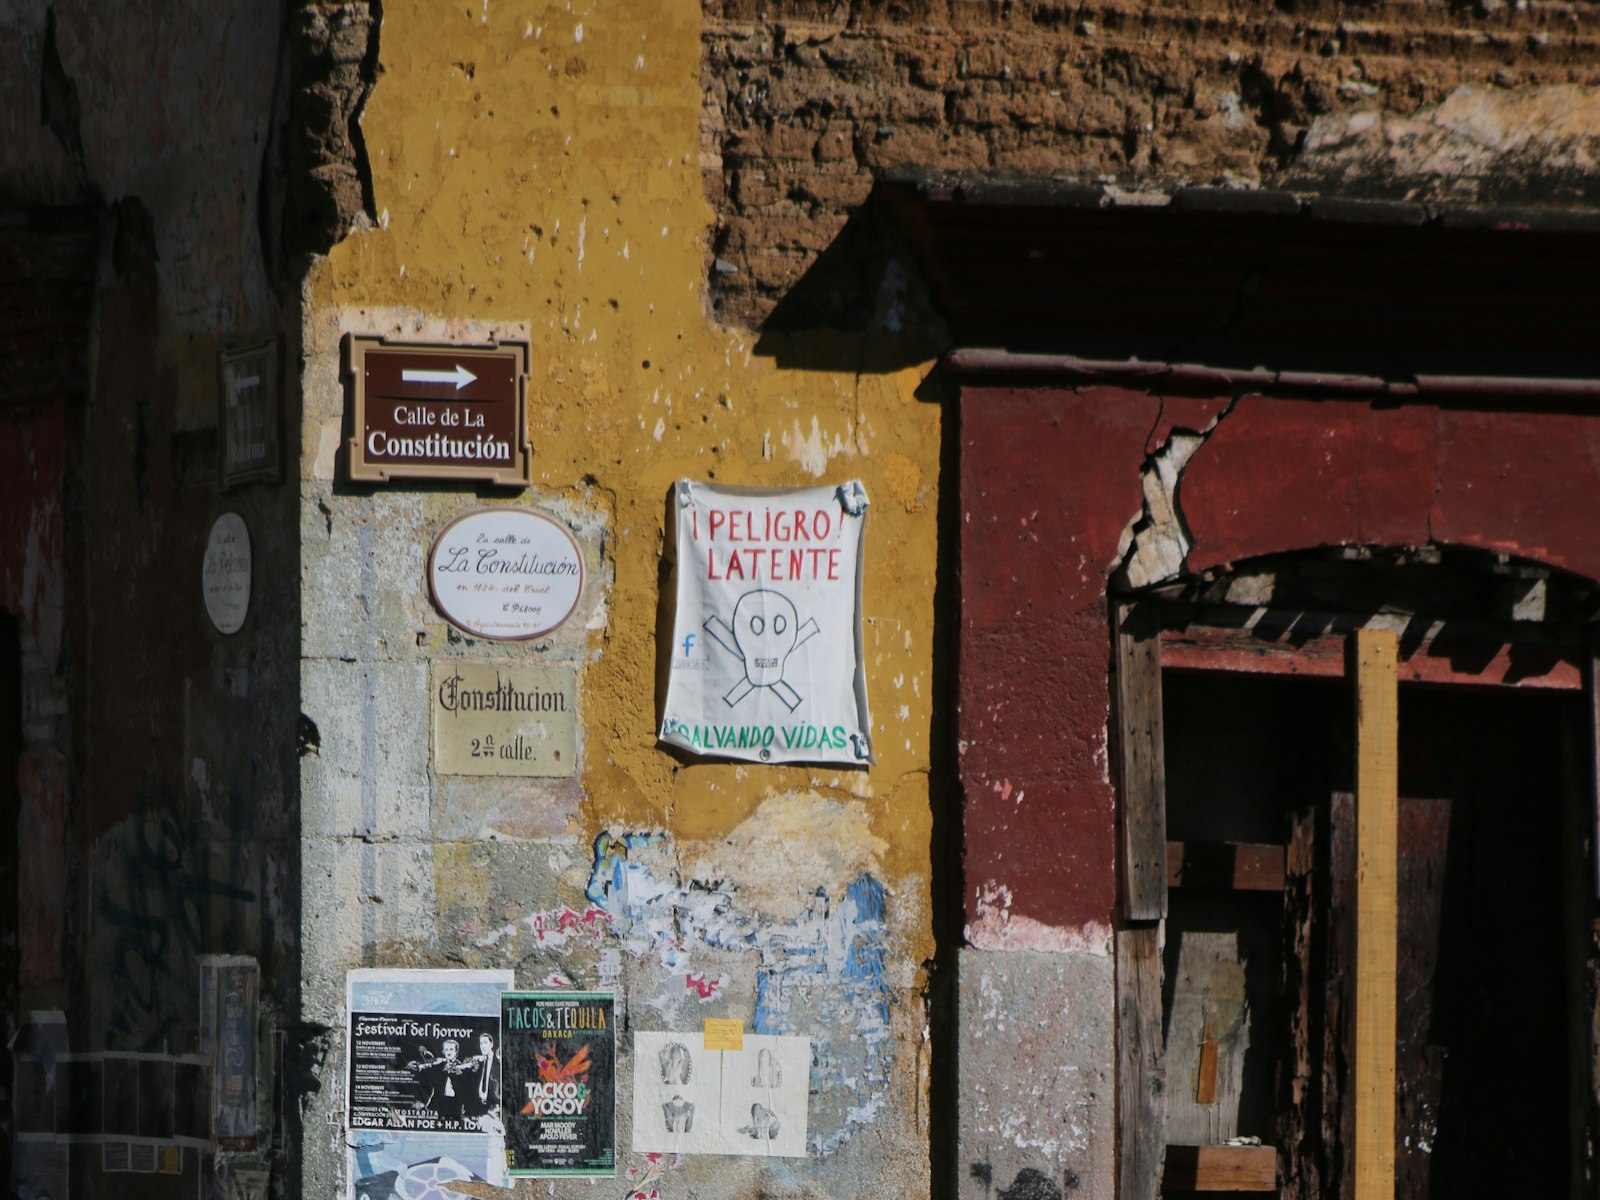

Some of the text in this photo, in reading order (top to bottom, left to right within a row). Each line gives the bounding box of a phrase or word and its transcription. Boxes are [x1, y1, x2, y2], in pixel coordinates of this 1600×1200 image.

[394, 406, 485, 427] Calle de La
[368, 431, 510, 460] Constitución
[492, 534, 516, 544] calle
[520, 536, 532, 544] de
[438, 547, 580, 576] La Constitución
[708, 548, 842, 580] LATENTE
[678, 720, 848, 750] SALVANDO VIDAS
[356, 1022, 474, 1040] Festival del horror
[542, 1030, 572, 1038] OAXACA
[530, 1098, 586, 1115] YOSOY
[352, 1118, 384, 1127] EDGAR
[417, 1120, 436, 1128] POE
[445, 1122, 462, 1130] H.P.
